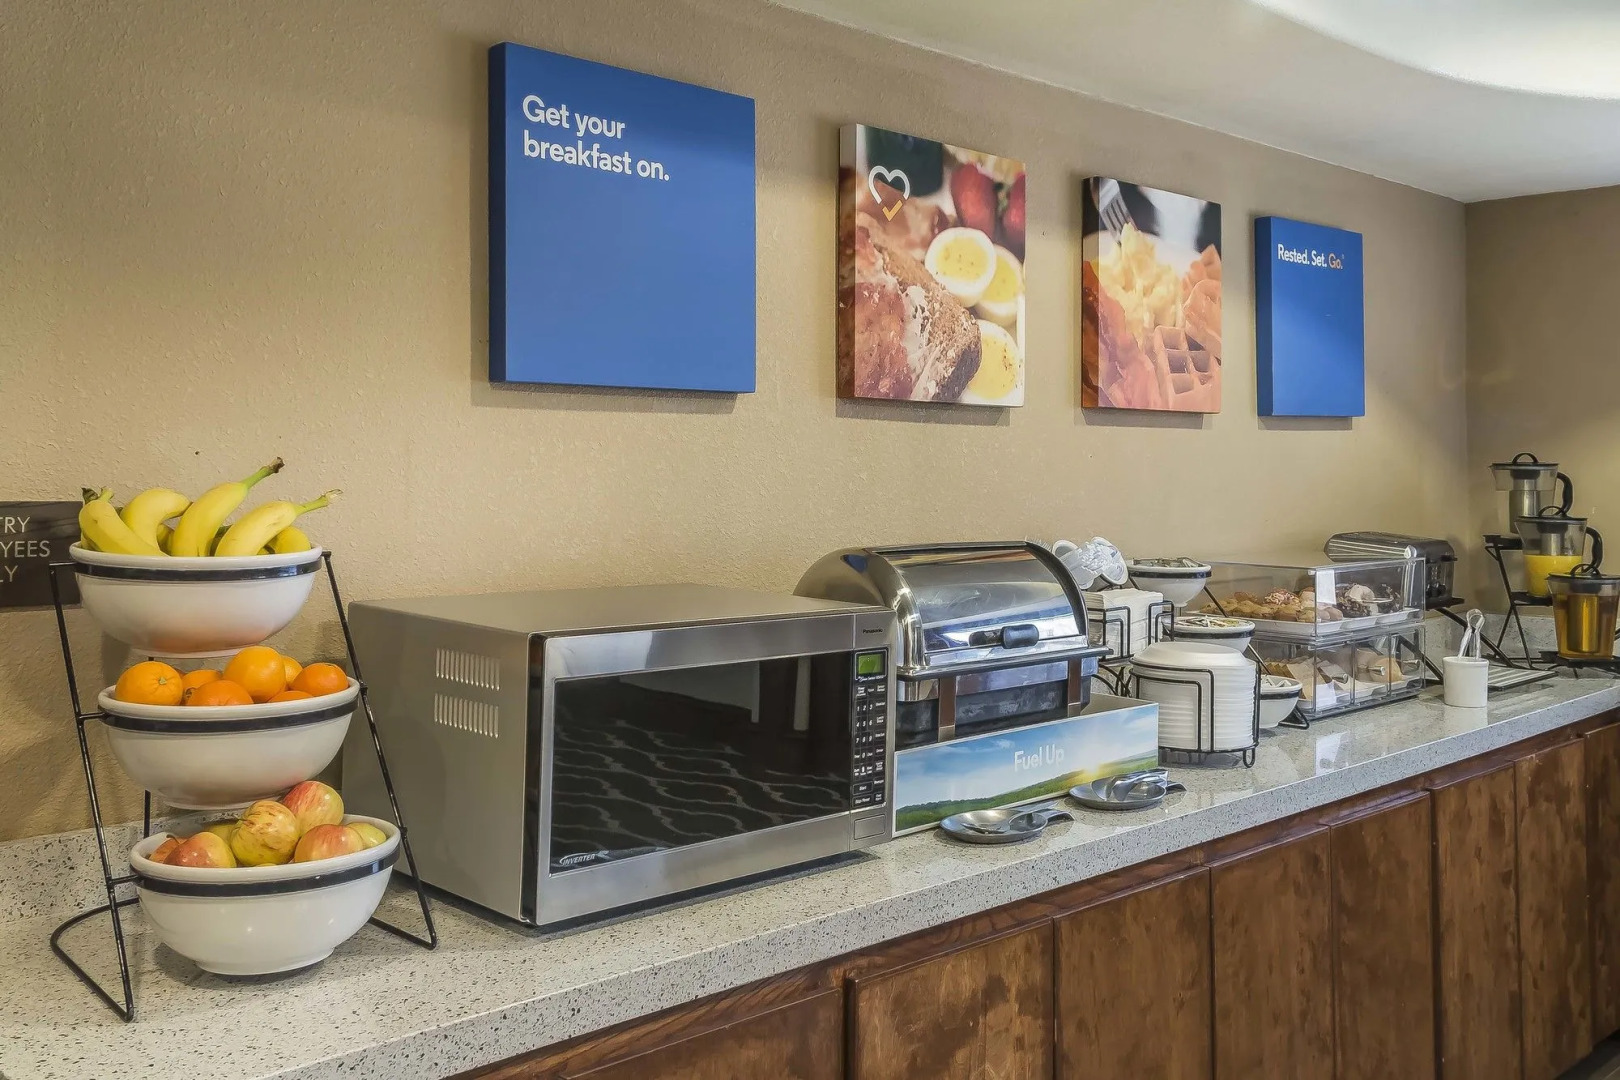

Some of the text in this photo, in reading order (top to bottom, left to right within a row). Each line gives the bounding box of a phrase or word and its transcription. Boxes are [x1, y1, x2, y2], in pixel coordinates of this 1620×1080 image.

[522, 94, 626, 139] Get your
[523, 129, 670, 182] breakfast on.
[1277, 243, 1310, 265] Rested.
[1311, 249, 1328, 268] Set.
[1014, 743, 1065, 772] Fuel Up
[562, 853, 596, 865] INVERTER
